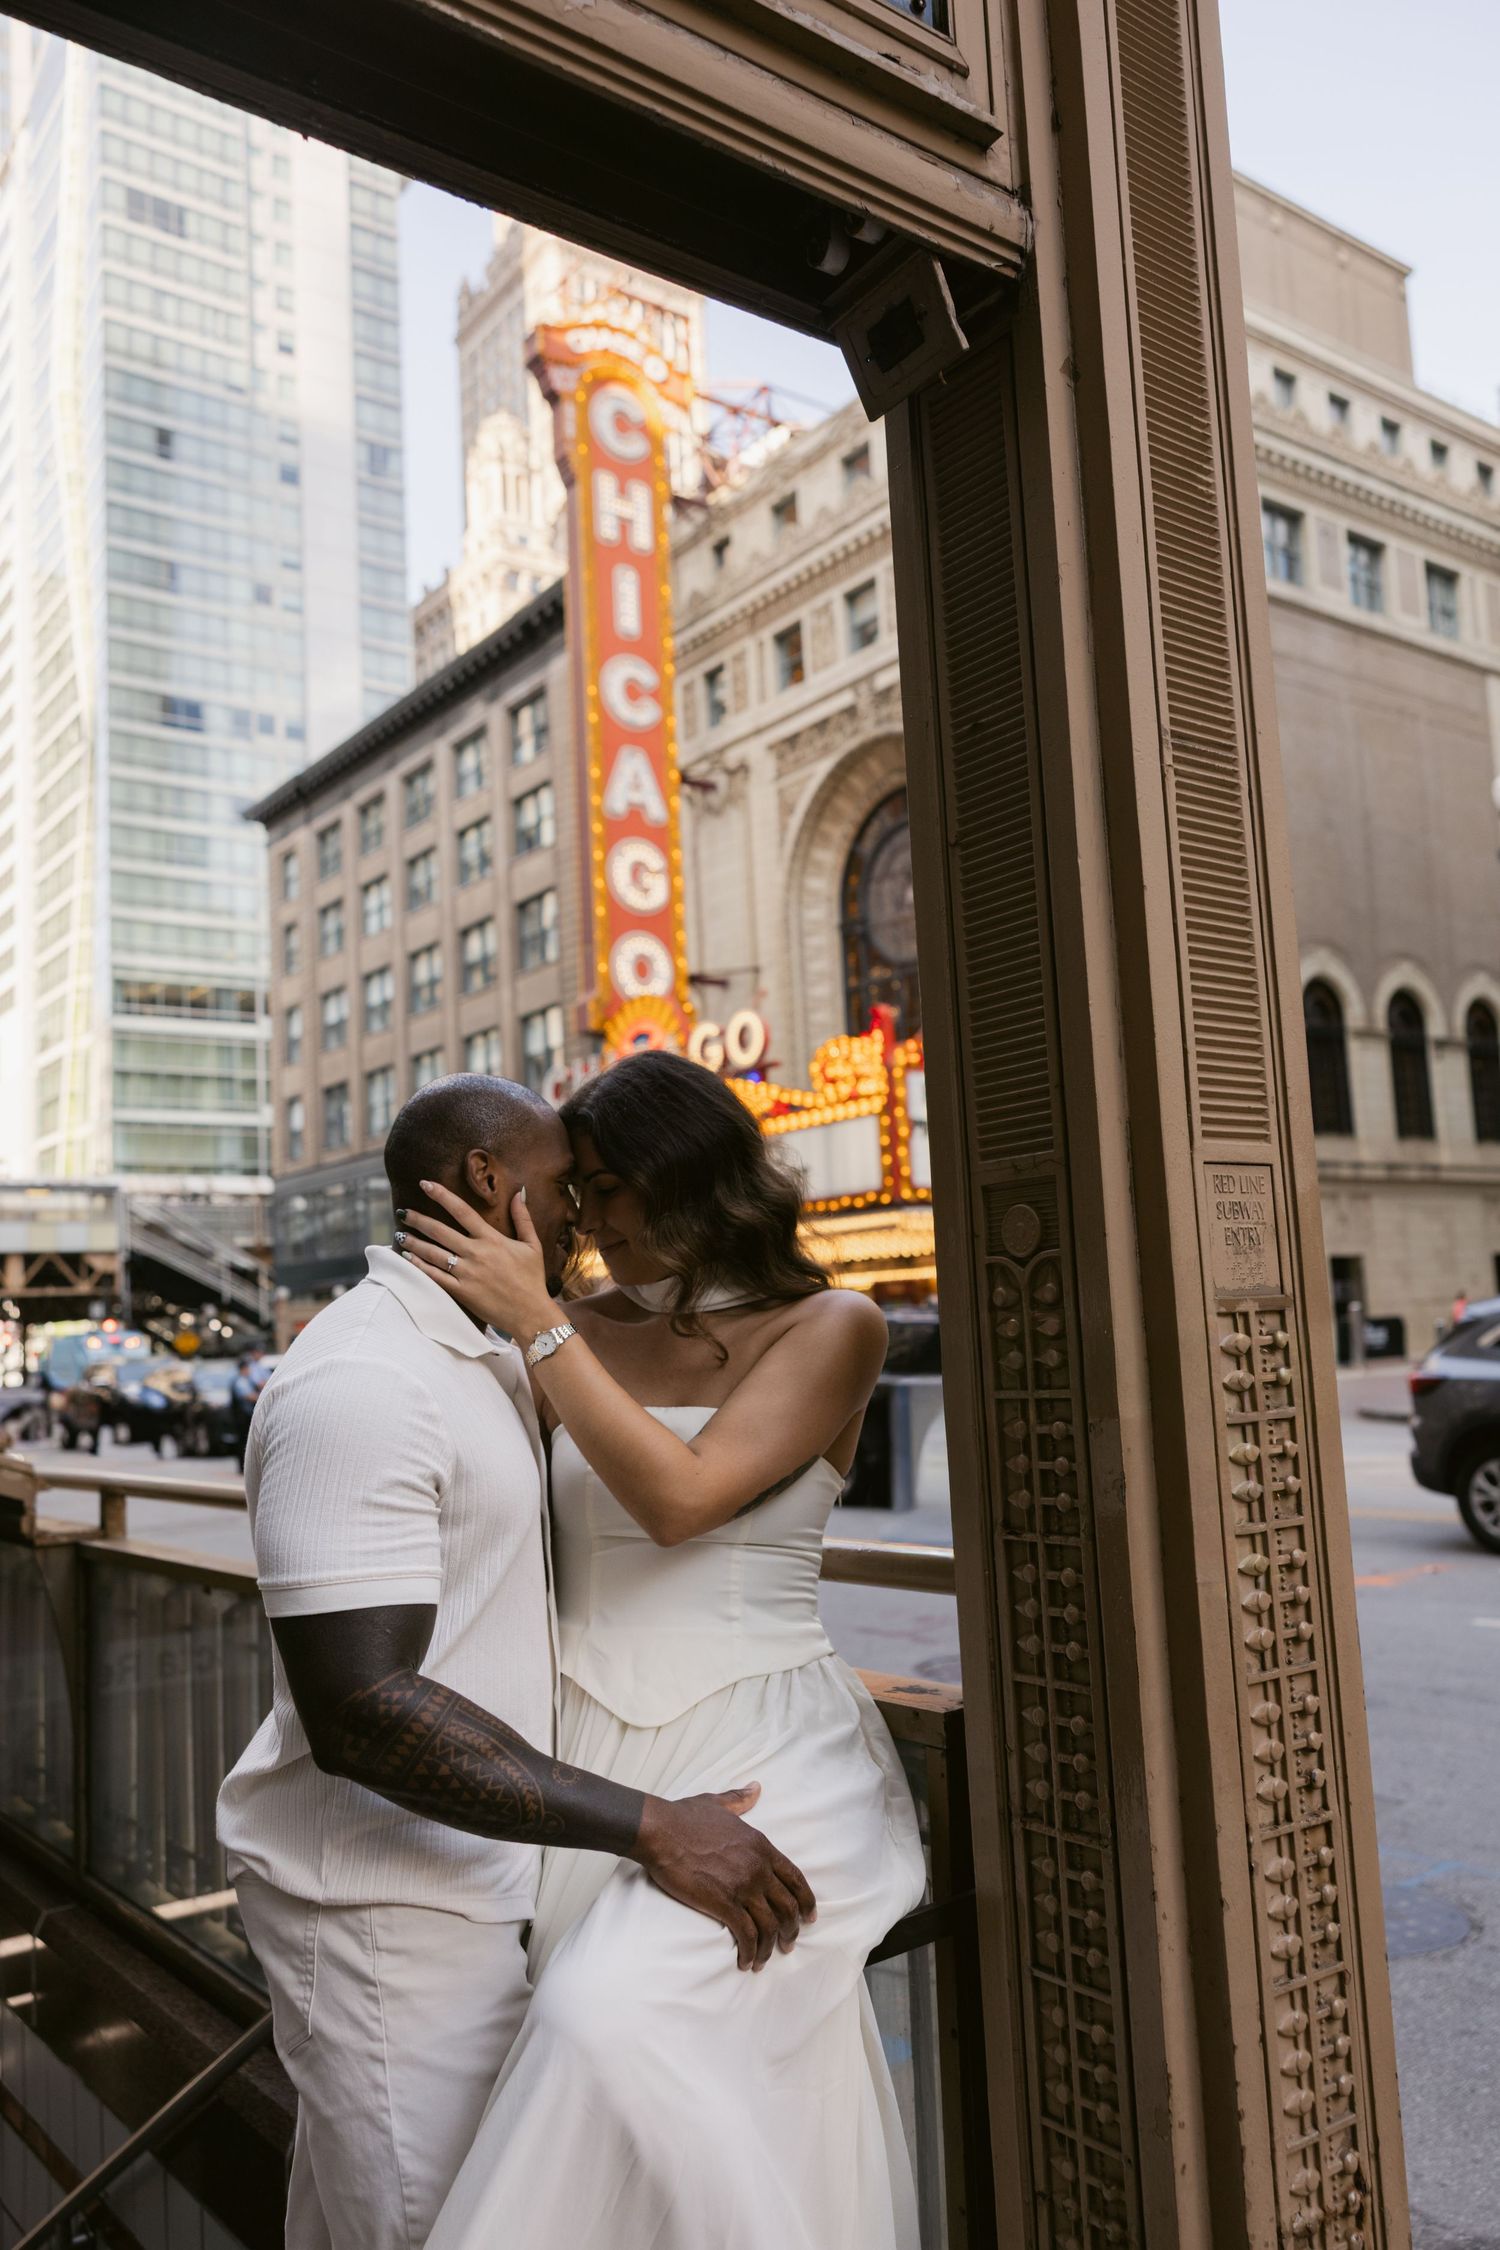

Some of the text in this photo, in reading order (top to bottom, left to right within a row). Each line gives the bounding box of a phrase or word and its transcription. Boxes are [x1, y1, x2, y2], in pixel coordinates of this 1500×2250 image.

[587, 383, 675, 1001] CHICAGO
[1212, 1174, 1266, 1195] RED LINE
[1216, 1200, 1266, 1221] SUBWAY
[1224, 1226, 1266, 1247] ENTRY
